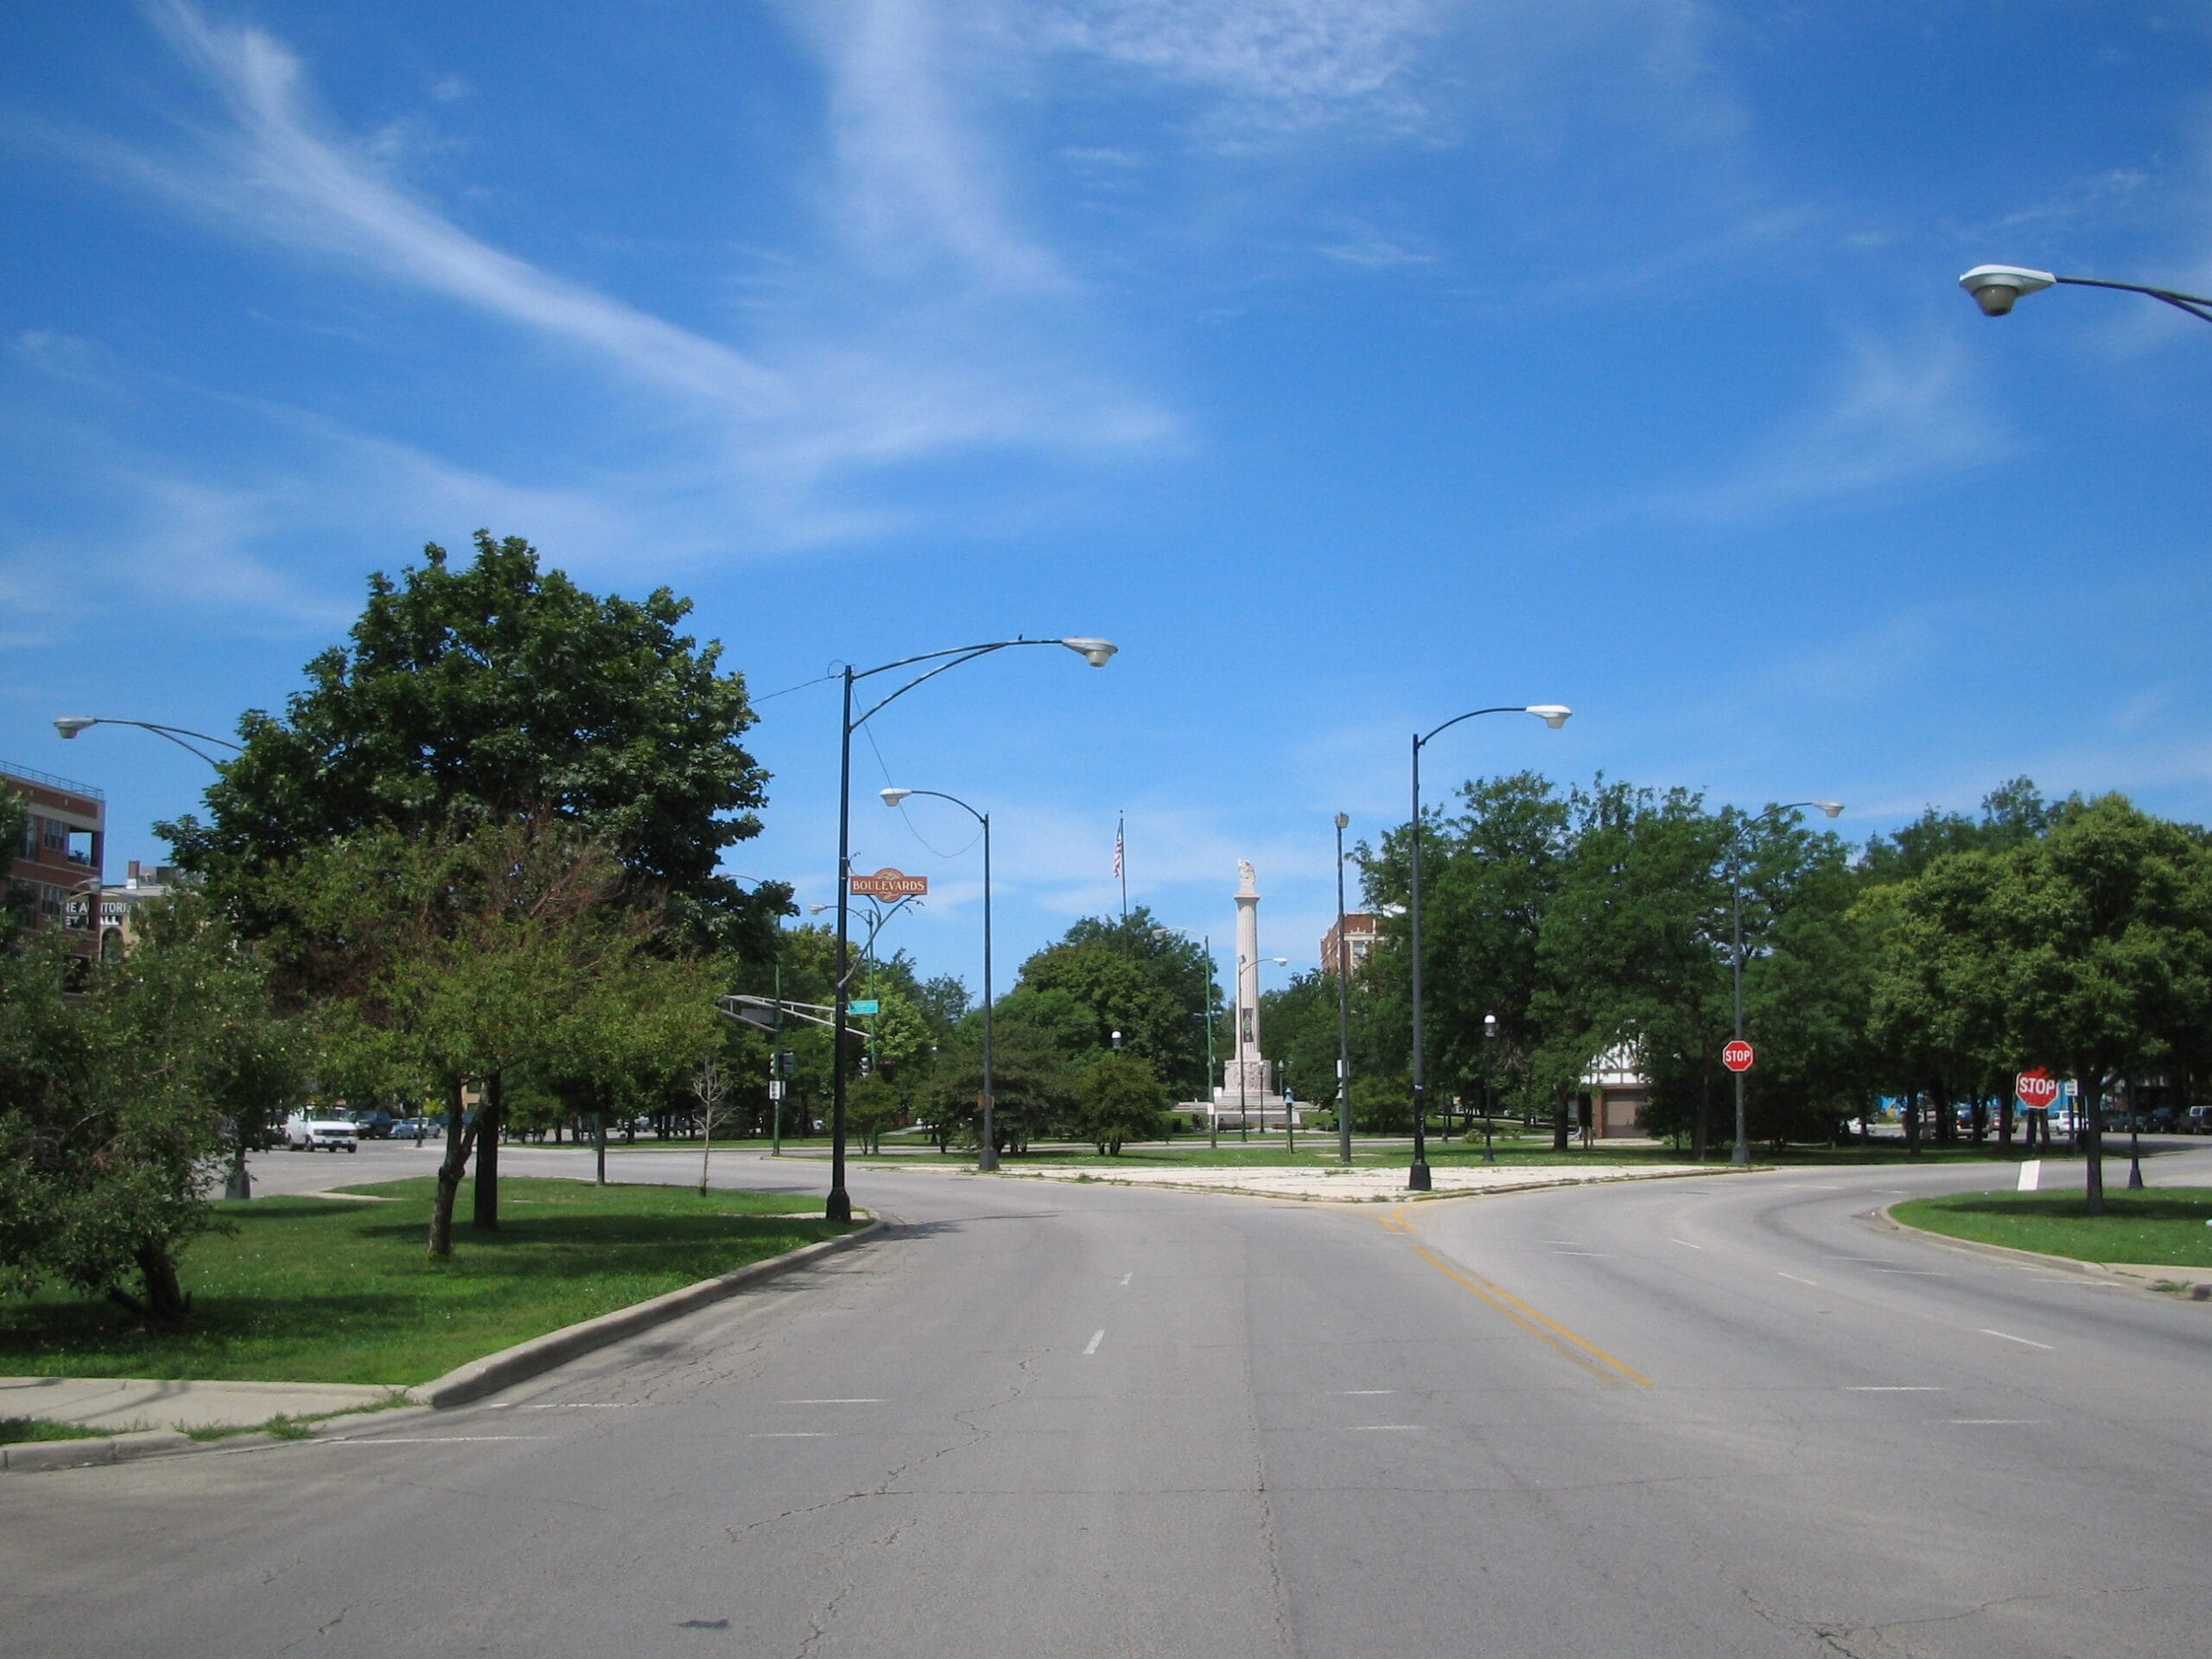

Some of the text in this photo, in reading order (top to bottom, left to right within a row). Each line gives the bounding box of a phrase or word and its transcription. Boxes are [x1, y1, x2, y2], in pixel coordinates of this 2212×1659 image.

[853, 880, 925, 891] BOULEVARDS
[1726, 1050, 1751, 1062] STOP
[2019, 1077, 2056, 1095] STOP
